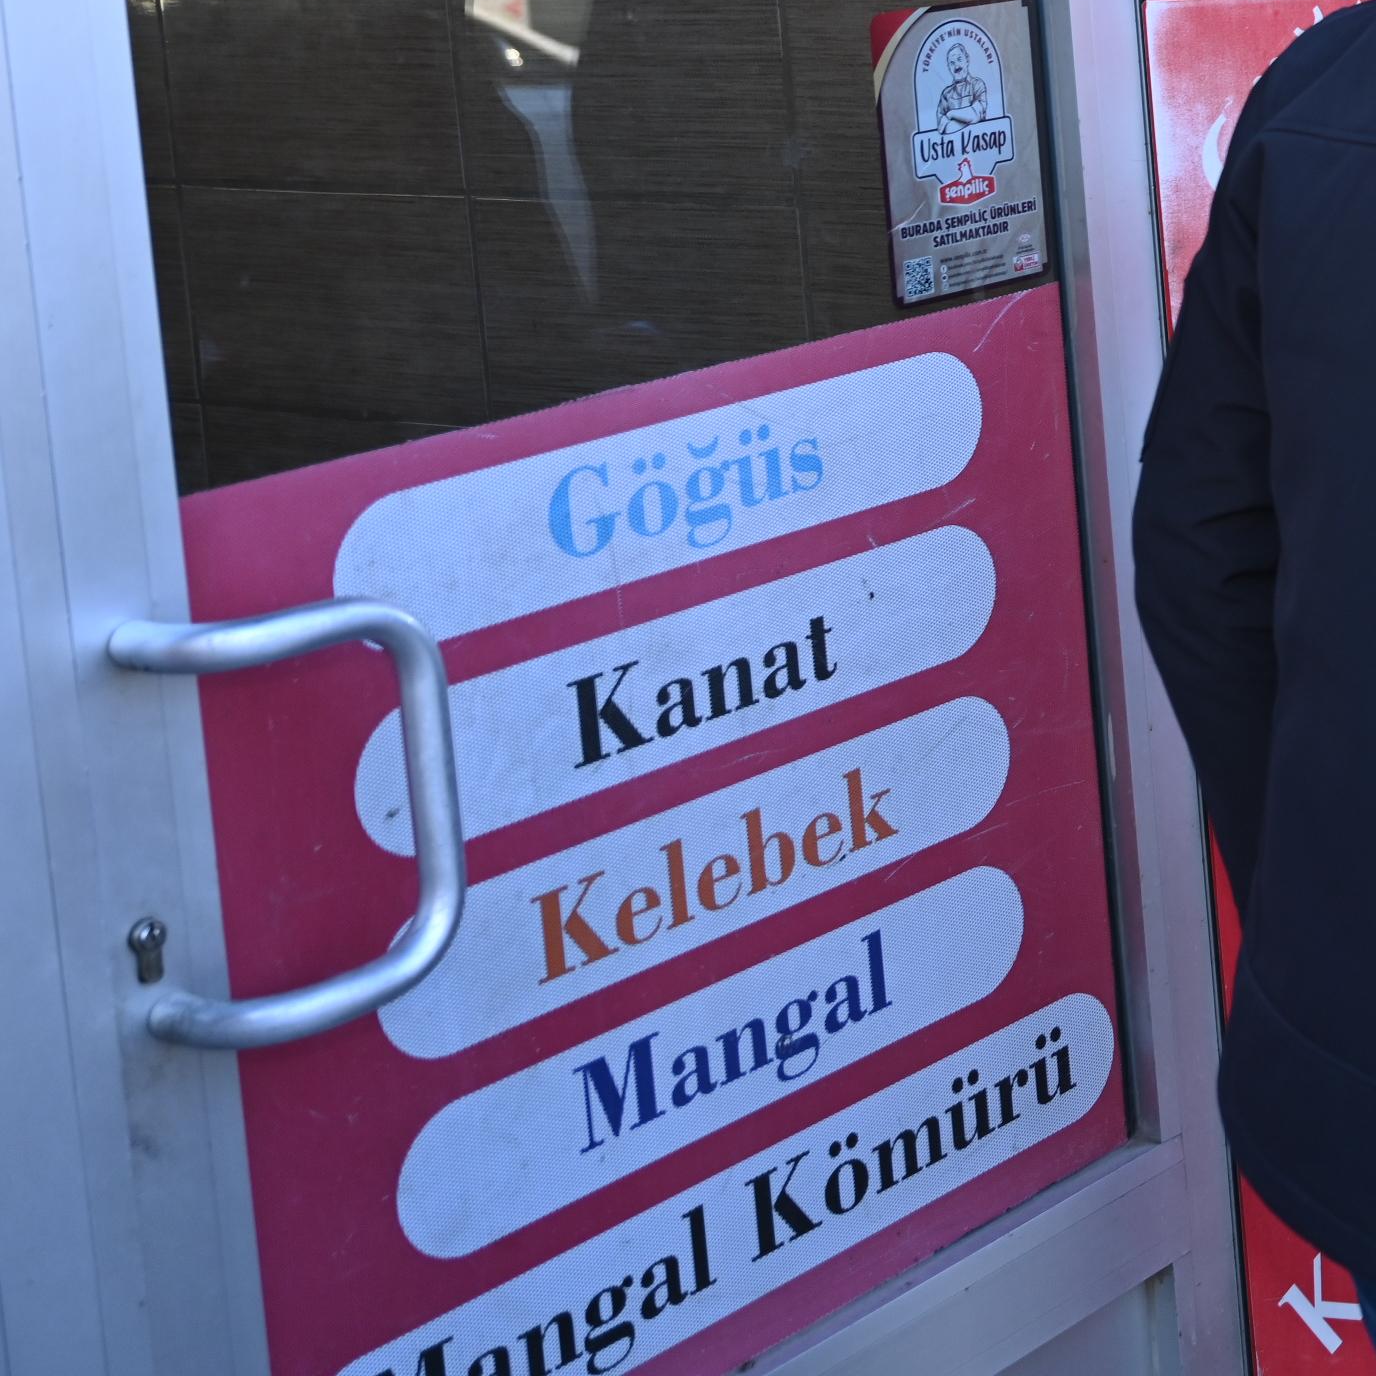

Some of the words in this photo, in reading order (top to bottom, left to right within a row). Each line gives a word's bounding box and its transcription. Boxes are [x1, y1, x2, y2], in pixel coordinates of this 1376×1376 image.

[921, 27, 962, 73] TÜRKİYE'NİN
[964, 28, 994, 64] USTALARI
[919, 135, 956, 164] Usta
[961, 128, 1007, 156] Kasap
[945, 177, 990, 201] şenpiliç
[900, 219, 943, 241] BURADA
[946, 209, 989, 233] ŞENPİLİÇ
[990, 198, 1037, 223] ÜRÜNLERİ
[932, 222, 1009, 249] SATILMAKTADIR
[547, 424, 825, 559] Göğüs
[567, 615, 839, 770] Kanat
[530, 767, 900, 985] Kelebek
[573, 930, 893, 1153] Mangal
[743, 1026, 1078, 1262] Kömürü
